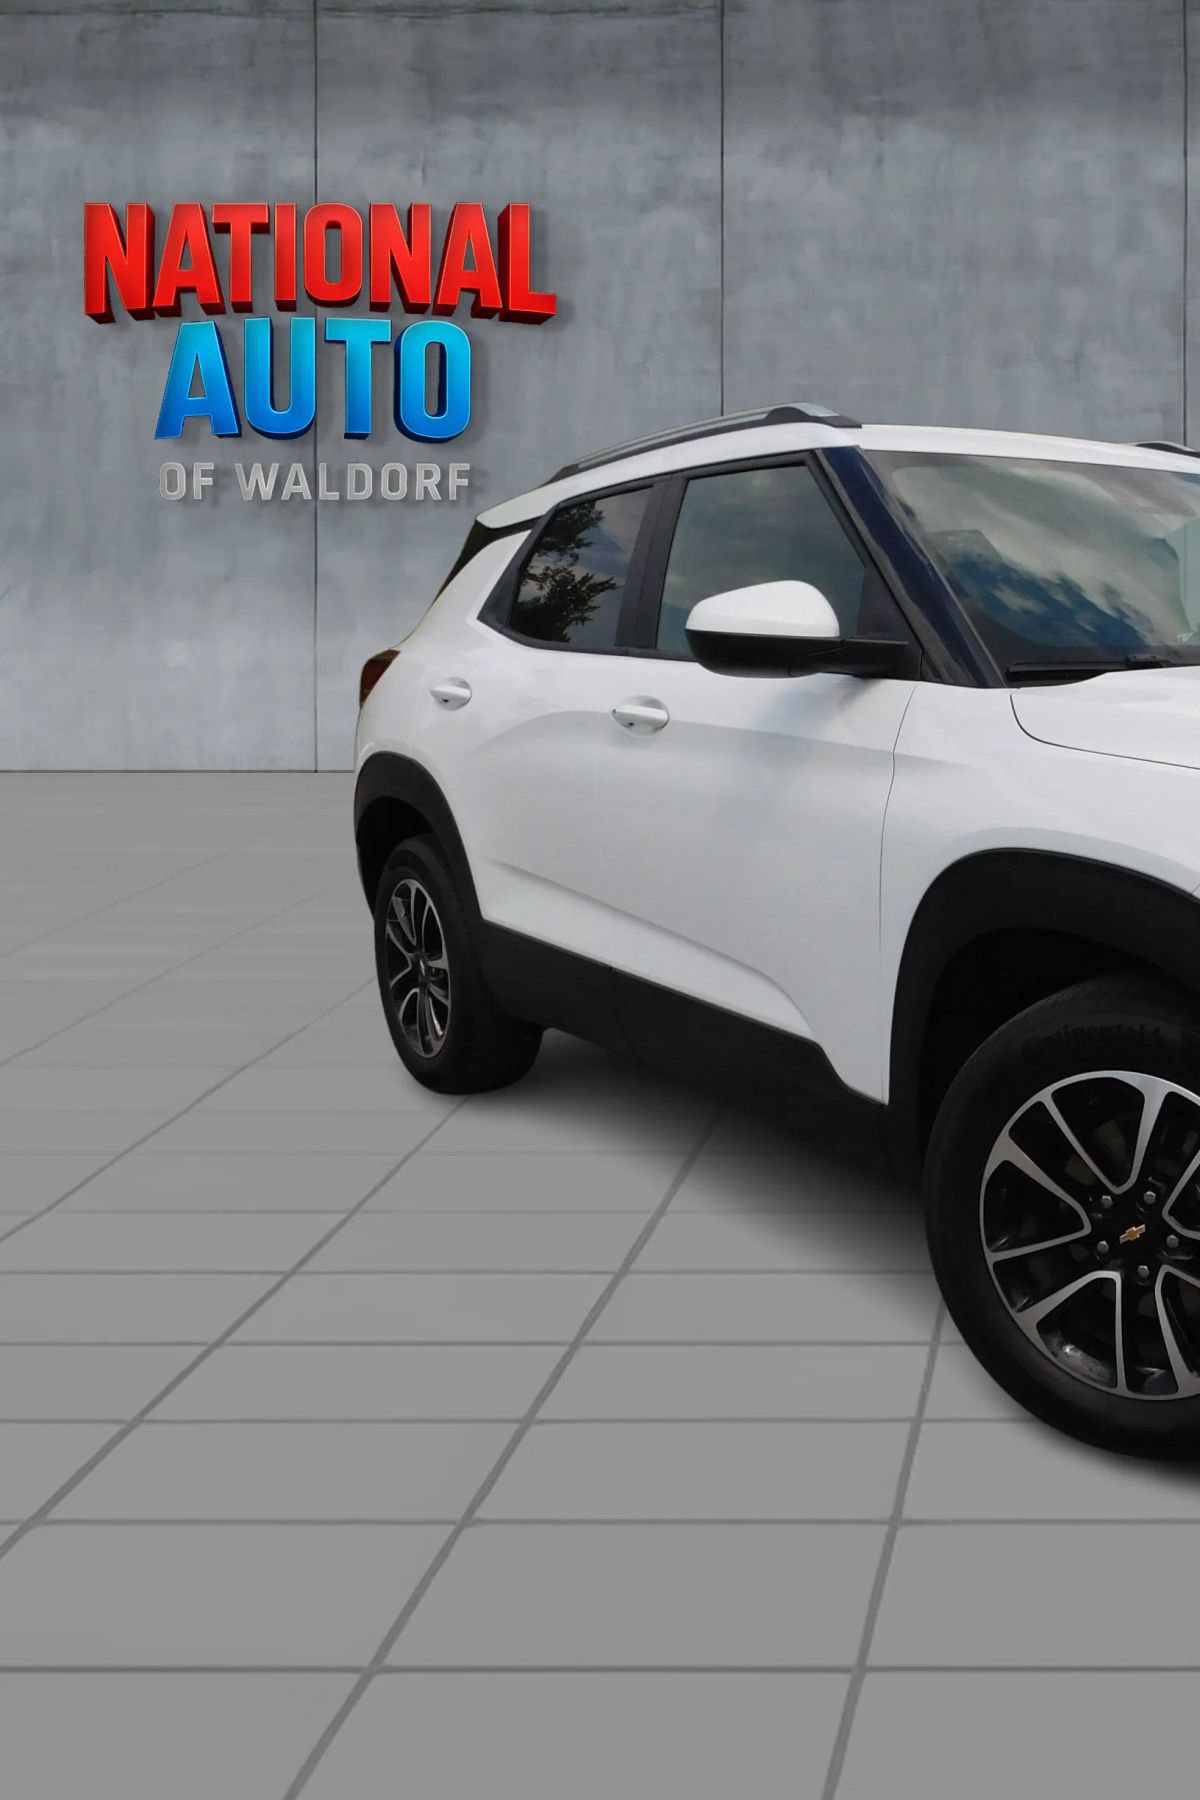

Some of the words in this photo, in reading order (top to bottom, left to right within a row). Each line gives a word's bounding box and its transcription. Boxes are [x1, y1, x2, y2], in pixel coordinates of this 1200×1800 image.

[84, 202, 557, 324] NATIONAL
[154, 317, 472, 443] AUTO
[158, 462, 215, 501] OF
[235, 462, 470, 501] WALDORF
